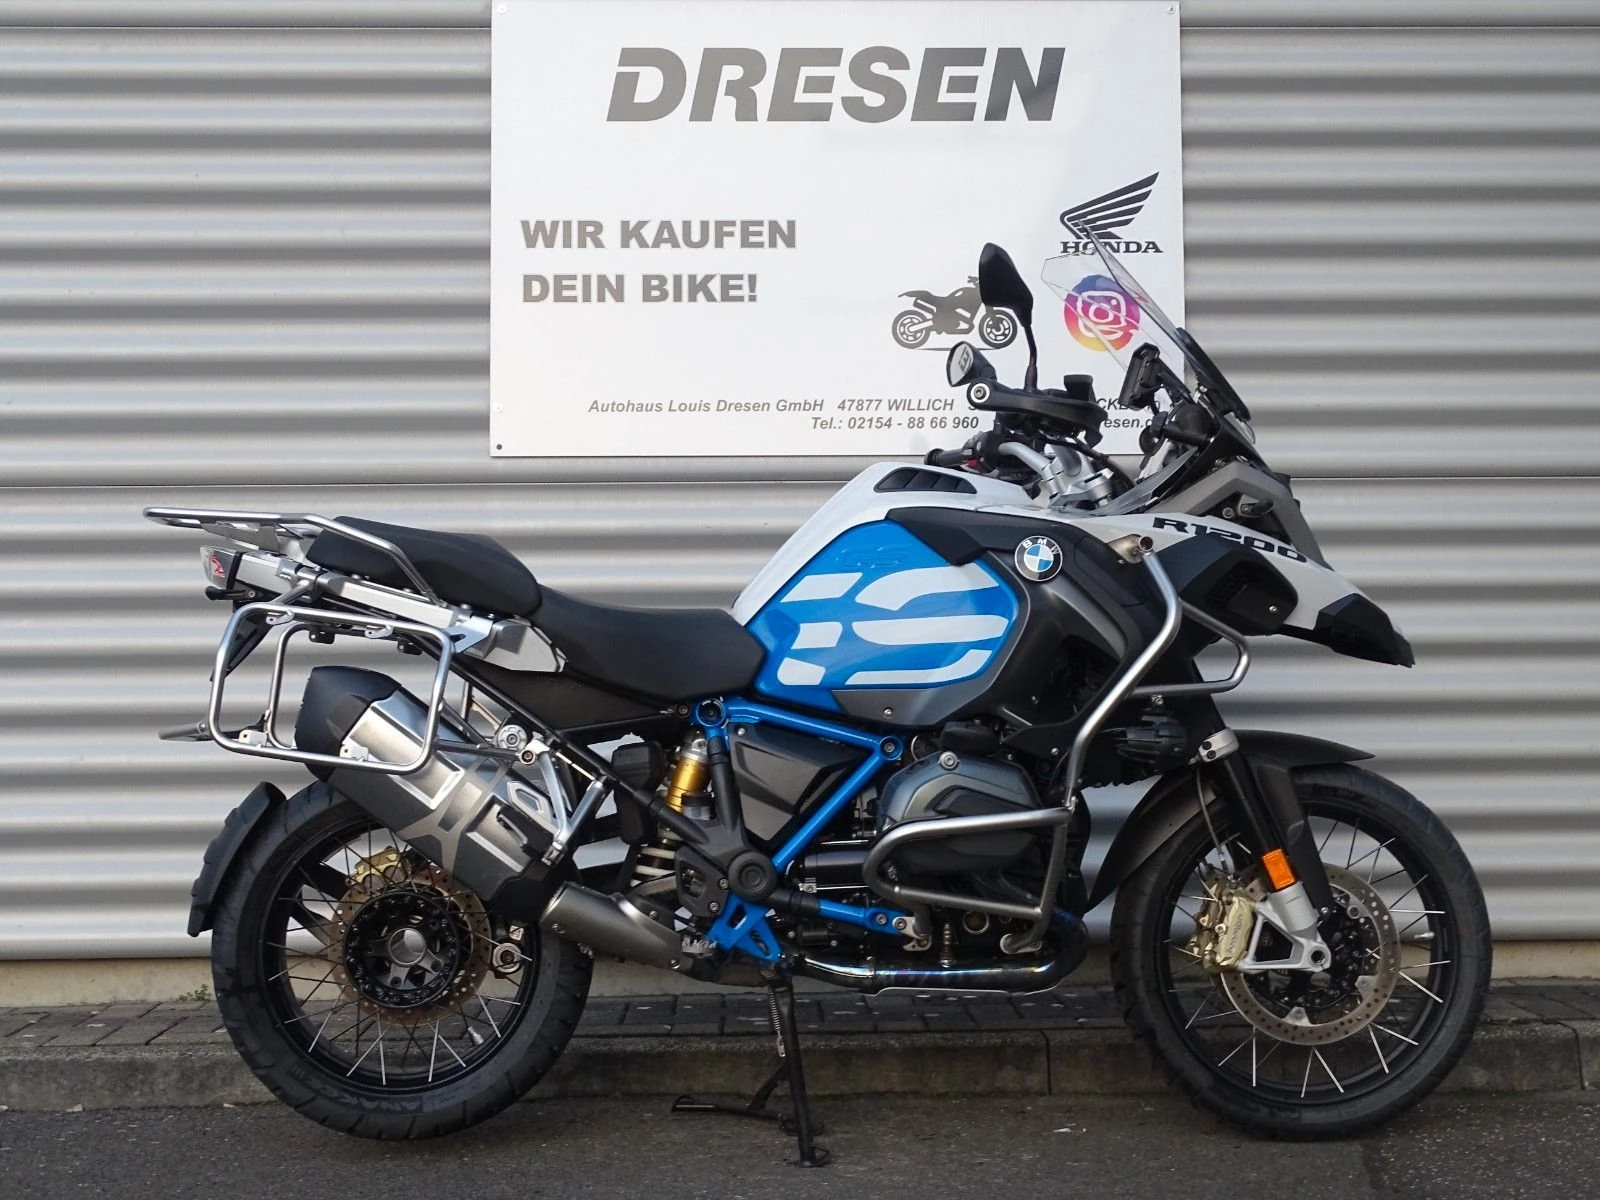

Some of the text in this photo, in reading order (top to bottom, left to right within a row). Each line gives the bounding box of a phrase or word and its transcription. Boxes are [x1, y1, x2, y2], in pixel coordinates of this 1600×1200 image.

[607, 46, 1065, 123] DRESEN
[521, 219, 796, 249] WIR KAUFEN
[1060, 240, 1164, 255] HONDA
[522, 273, 758, 303] DEIN BIKE!
[588, 399, 664, 413] Autohaus
[668, 399, 711, 413] Louis
[716, 399, 771, 412] Dresen
[776, 398, 825, 412] GmbH
[837, 398, 883, 412] 47877
[887, 398, 955, 412] WILLICH
[811, 416, 843, 430] Tel.:
[848, 416, 893, 430] 02154
[907, 416, 926, 430] 88
[930, 416, 948, 430] 66
[952, 416, 980, 430] 960
[1022, 538, 1061, 555] BMW
[1152, 516, 1308, 563] R1200
